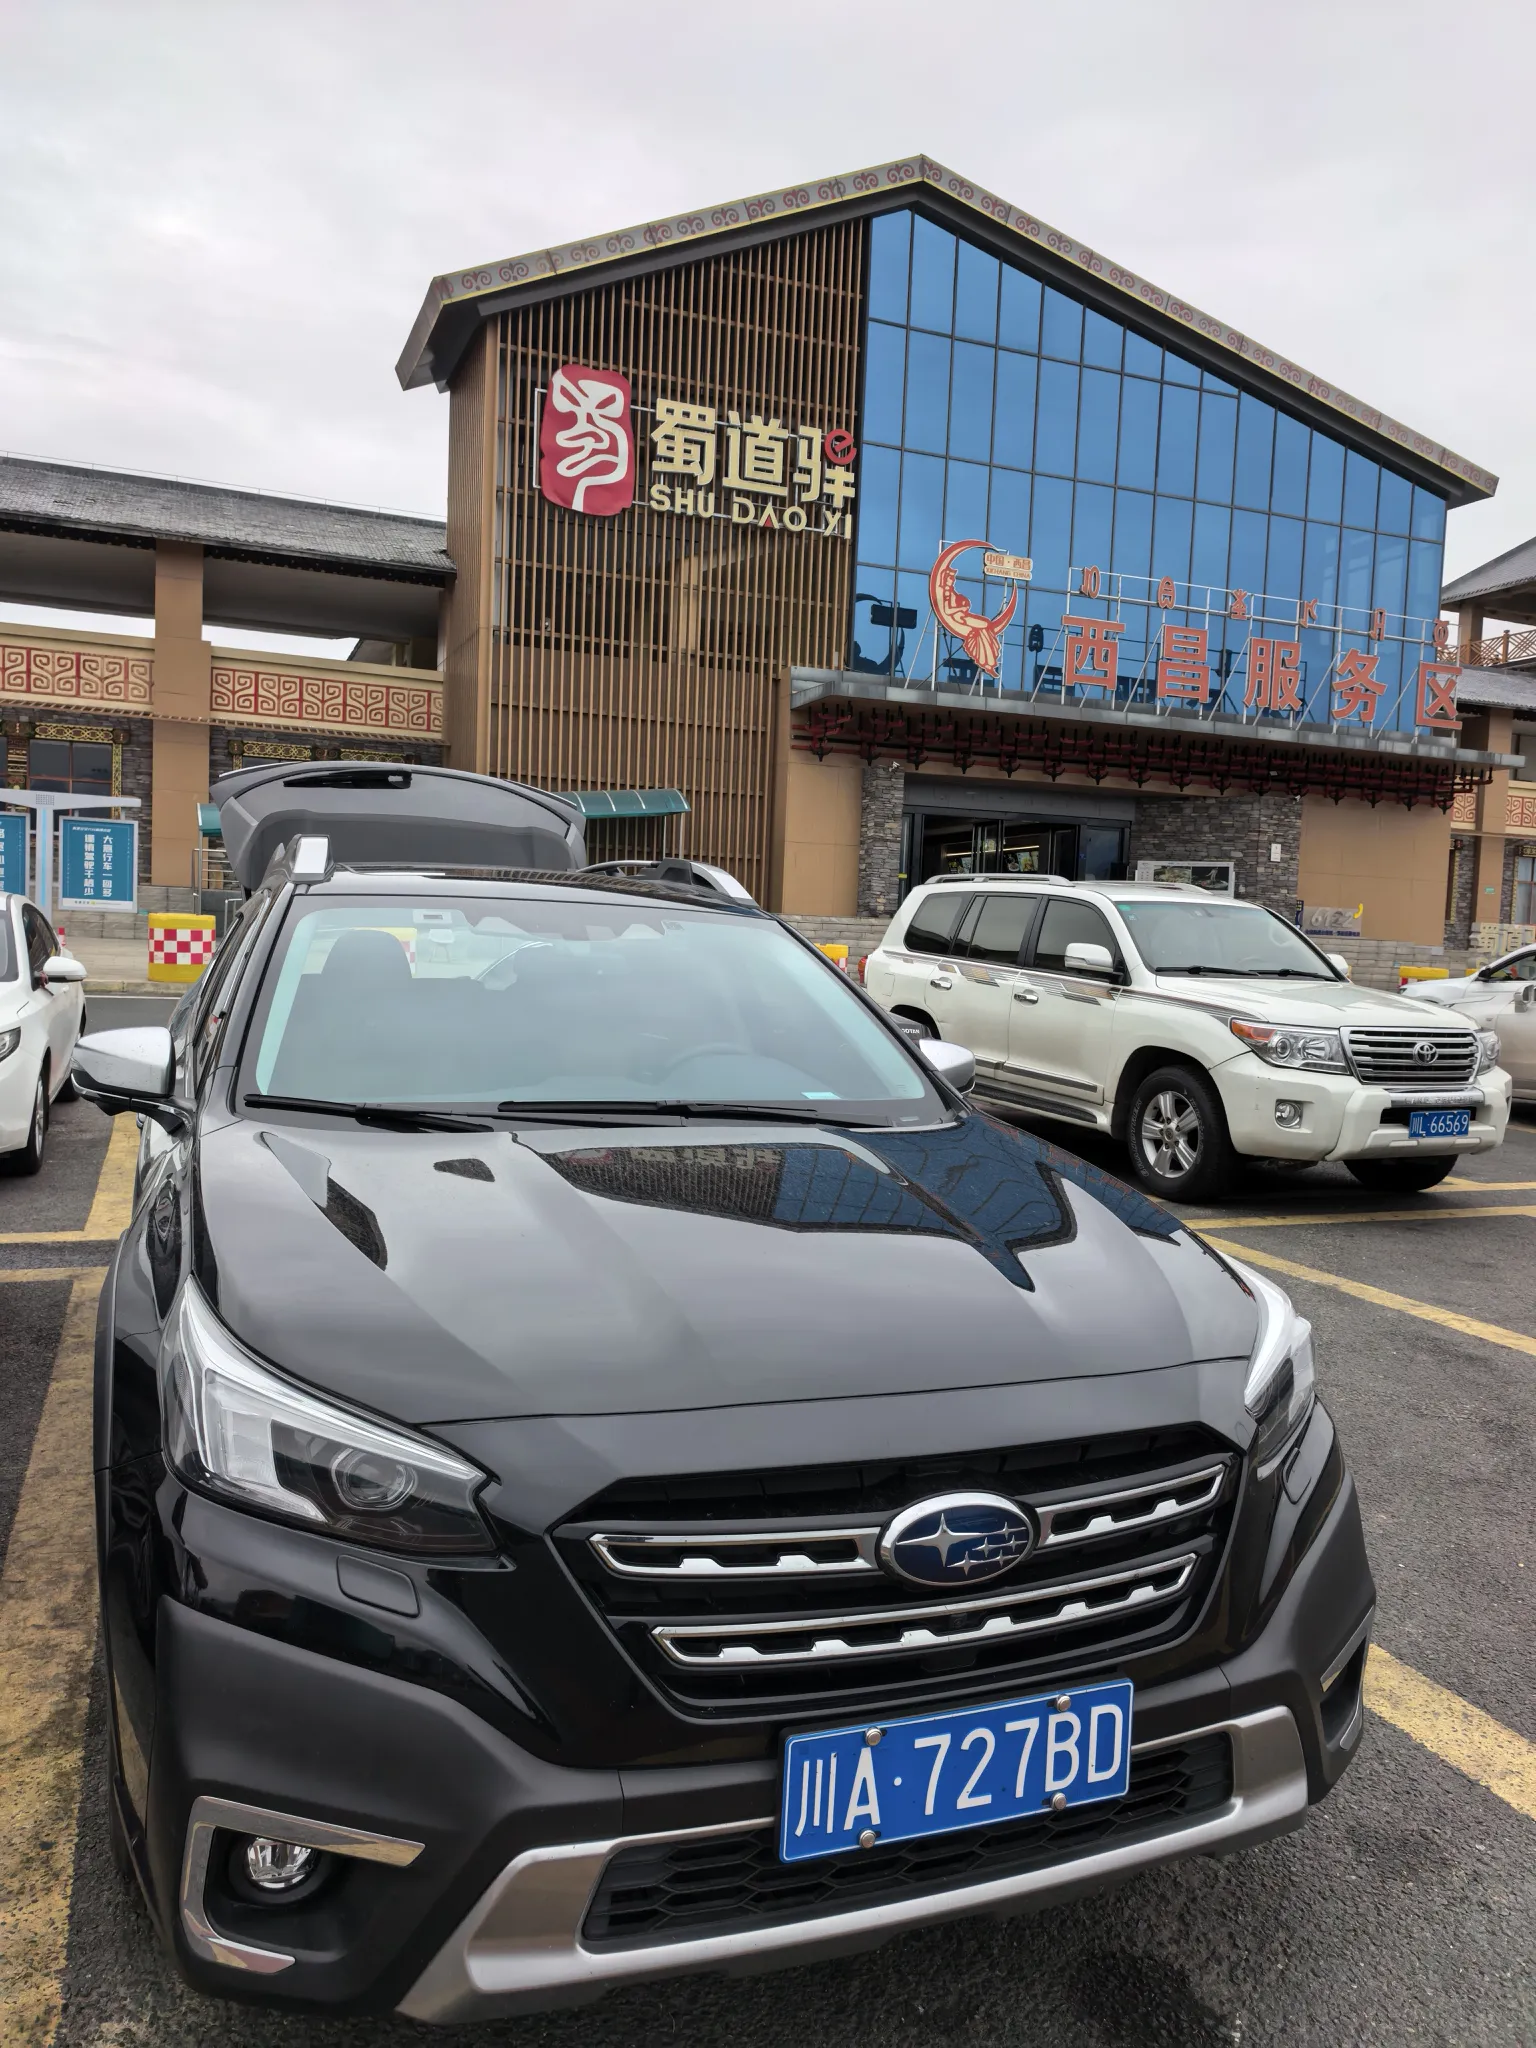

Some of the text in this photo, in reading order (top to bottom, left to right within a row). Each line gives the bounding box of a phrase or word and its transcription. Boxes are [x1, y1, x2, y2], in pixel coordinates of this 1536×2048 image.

[650, 397, 857, 508] 蜀道驿
[650, 484, 853, 539] SHU DAO YI
[986, 567, 1030, 579] XICHANG CHINA
[1062, 615, 1463, 731] 西昌服务区
